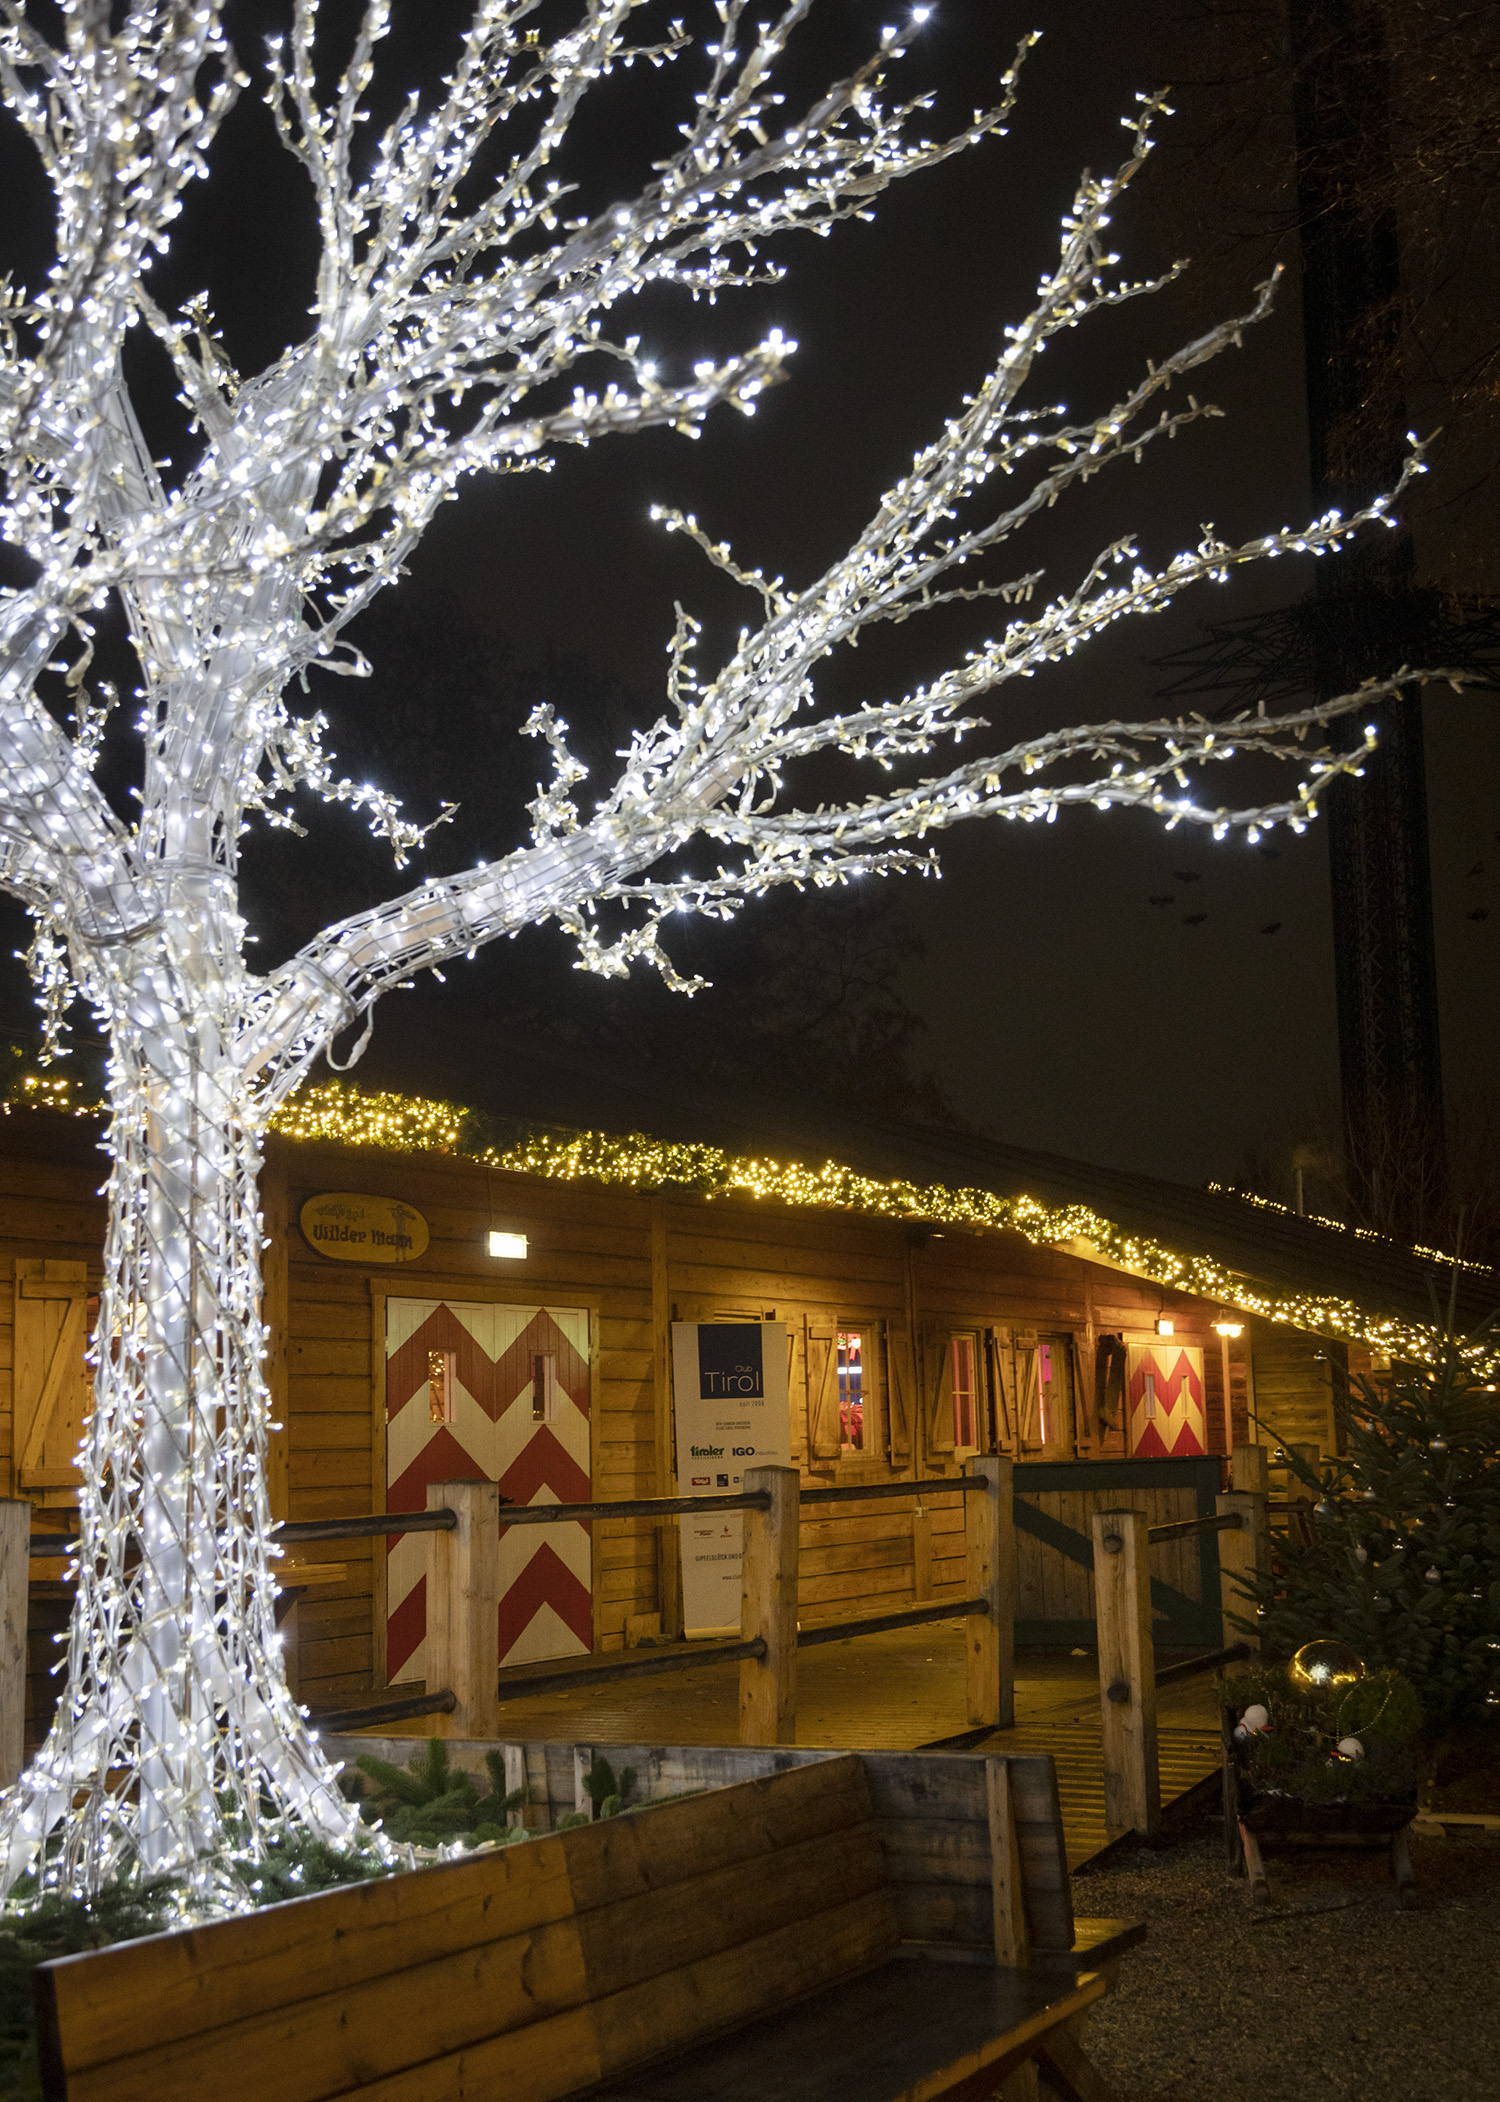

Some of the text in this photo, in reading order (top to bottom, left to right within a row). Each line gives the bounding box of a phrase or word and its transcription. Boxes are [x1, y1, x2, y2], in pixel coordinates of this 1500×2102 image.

[313, 1225, 367, 1243] Wilder
[735, 1365, 753, 1373] Club
[704, 1371, 759, 1392] Tirol
[690, 1444, 725, 1457] tiroler
[732, 1446, 755, 1457] IGO
